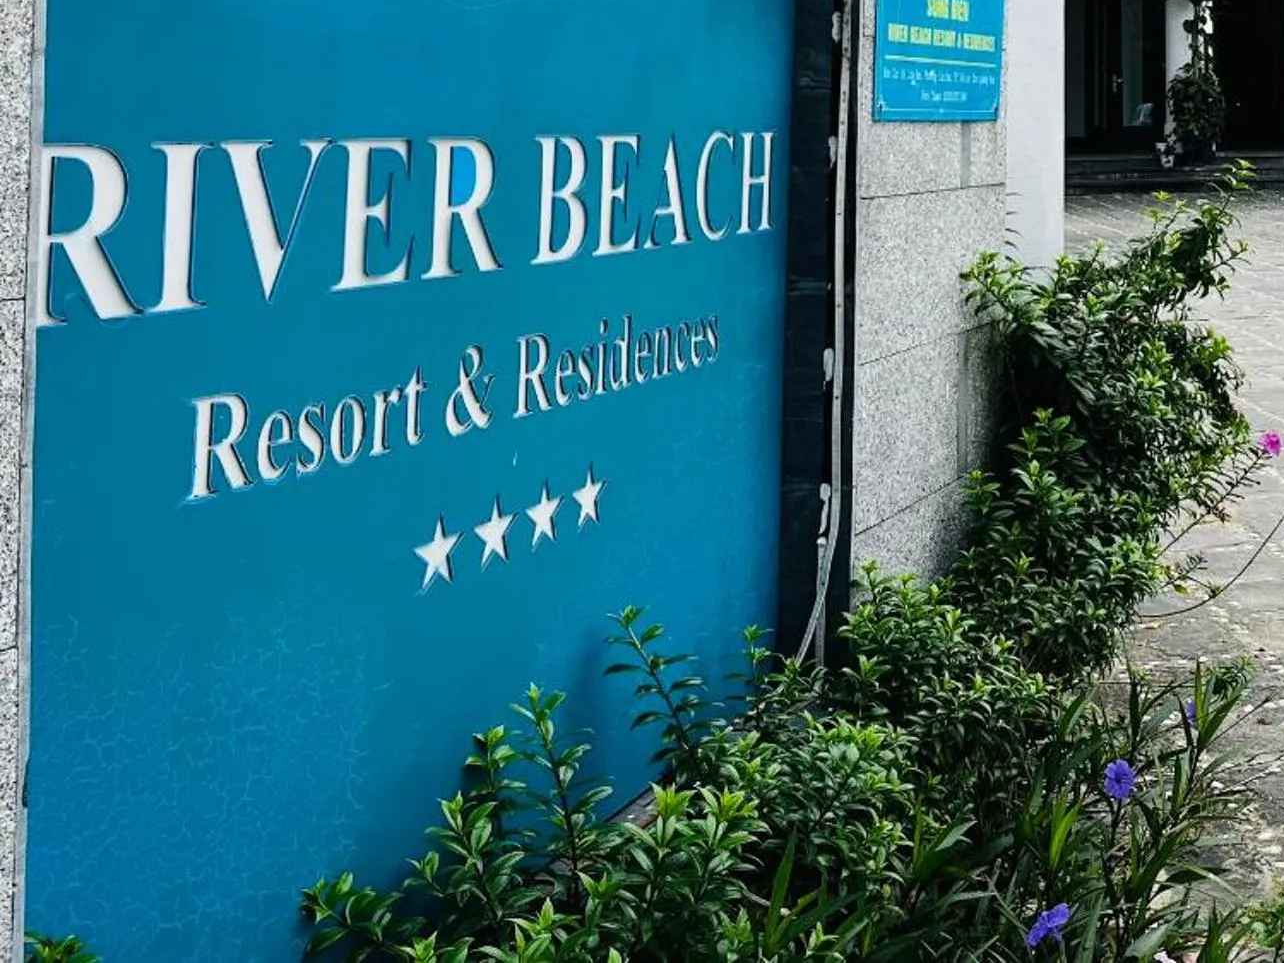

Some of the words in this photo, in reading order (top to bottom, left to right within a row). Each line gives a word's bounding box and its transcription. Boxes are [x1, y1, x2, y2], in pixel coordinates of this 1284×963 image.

[36, 137, 502, 327] RIVER
[530, 129, 777, 267] BEACH
[187, 367, 426, 500] Resort
[445, 344, 494, 437] &
[513, 313, 721, 419] Residences
